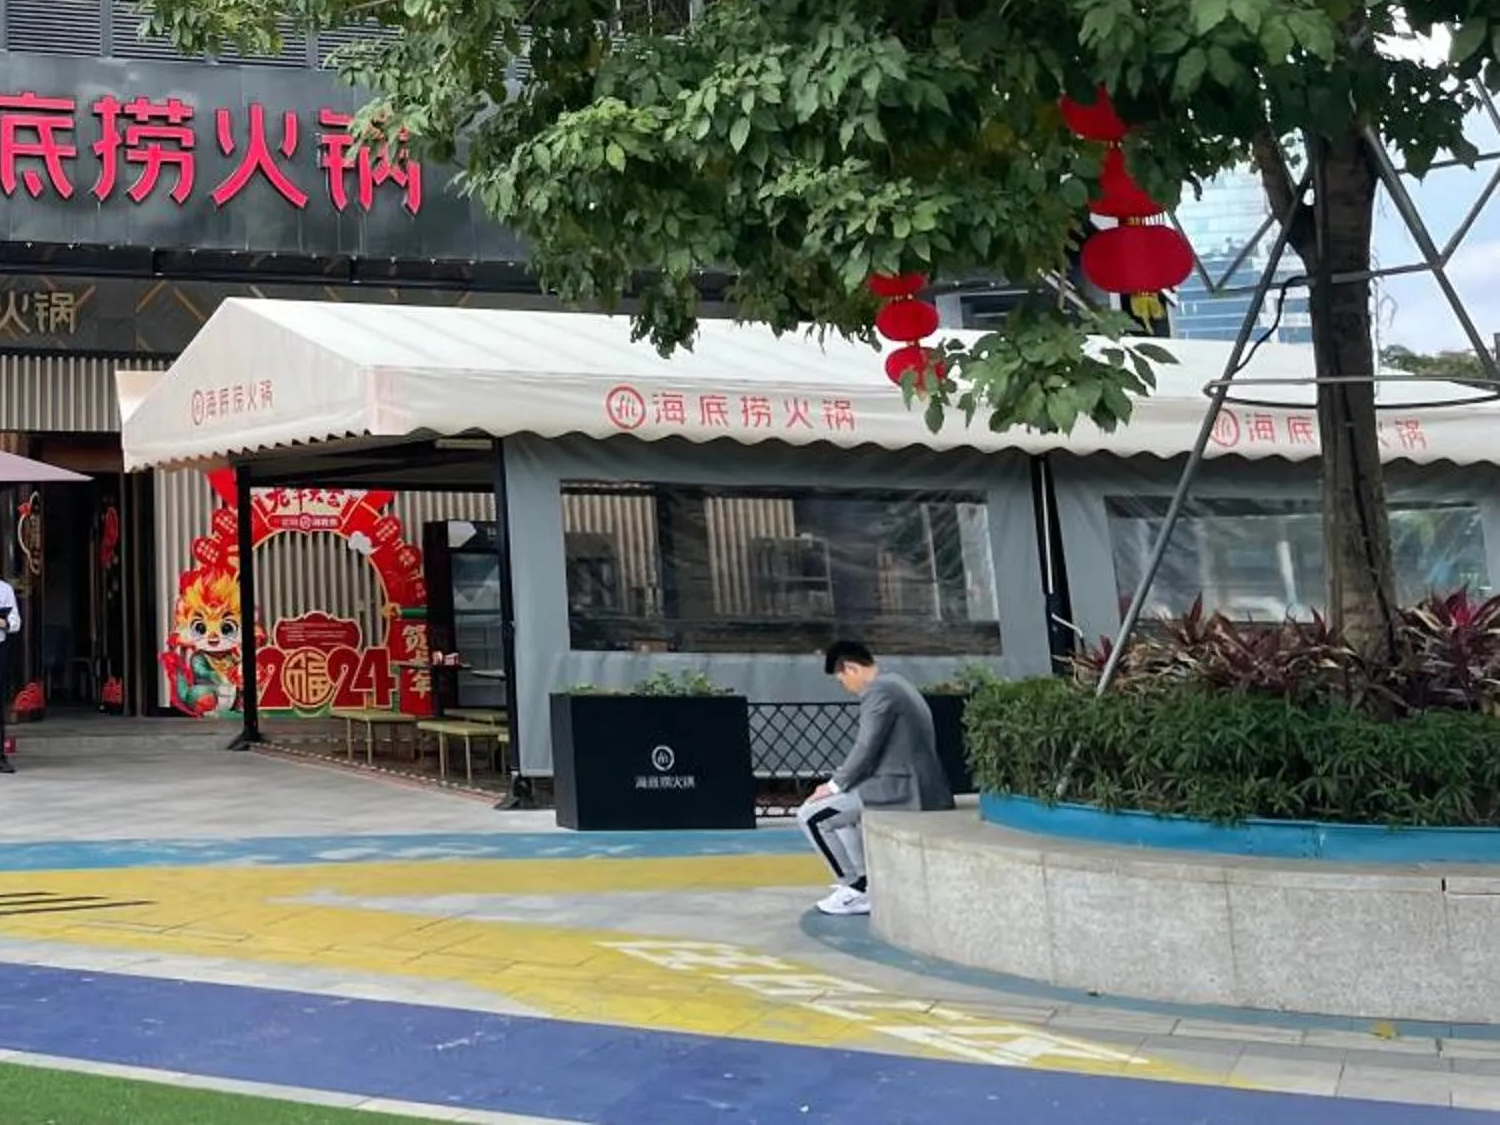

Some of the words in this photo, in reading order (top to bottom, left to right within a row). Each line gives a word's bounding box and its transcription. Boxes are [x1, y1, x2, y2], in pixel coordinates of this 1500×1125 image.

[652, 392, 856, 432] 海底捞火锅
